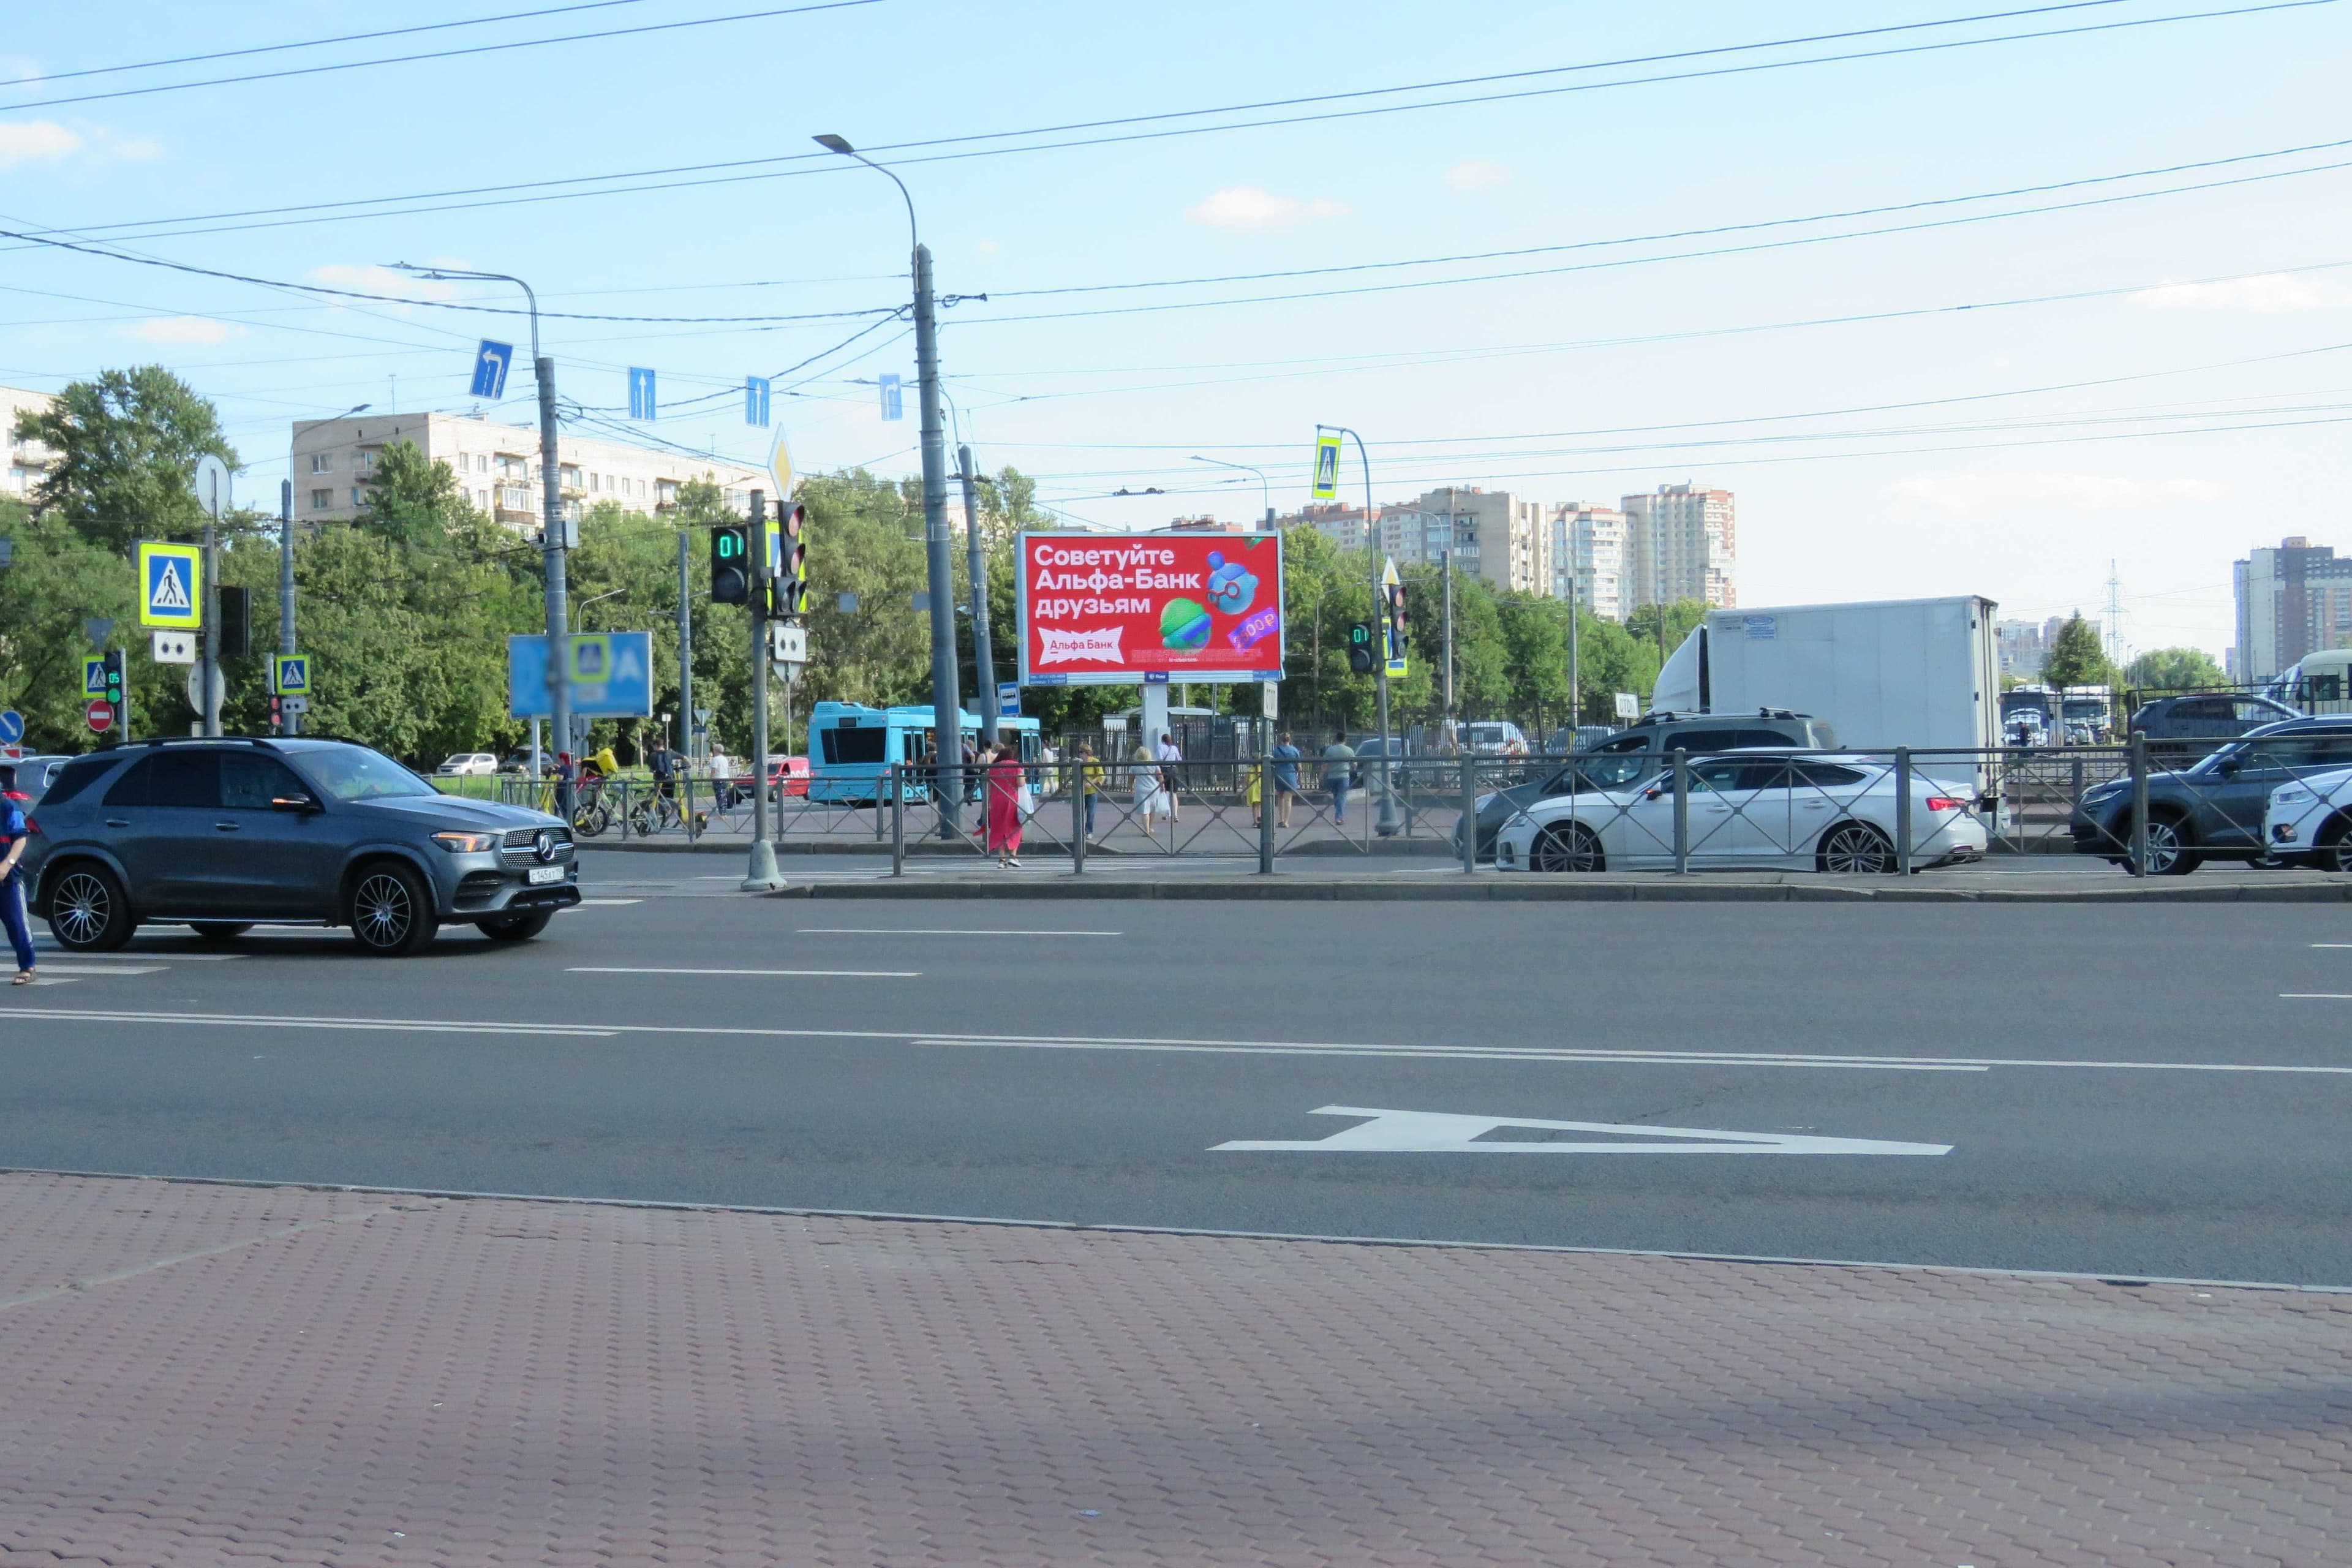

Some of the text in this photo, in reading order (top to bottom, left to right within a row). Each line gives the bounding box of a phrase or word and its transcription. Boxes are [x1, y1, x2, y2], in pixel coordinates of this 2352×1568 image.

[720, 535, 741, 557] 01
[1035, 543, 1175, 571] Советуйте
[1035, 568, 1201, 595] Альфа-Банк
[1035, 598, 1152, 620] друзьям
[1050, 639, 1113, 650] Альфа Банк
[1354, 629, 1368, 643] 01
[108, 673, 119, 684] 05
